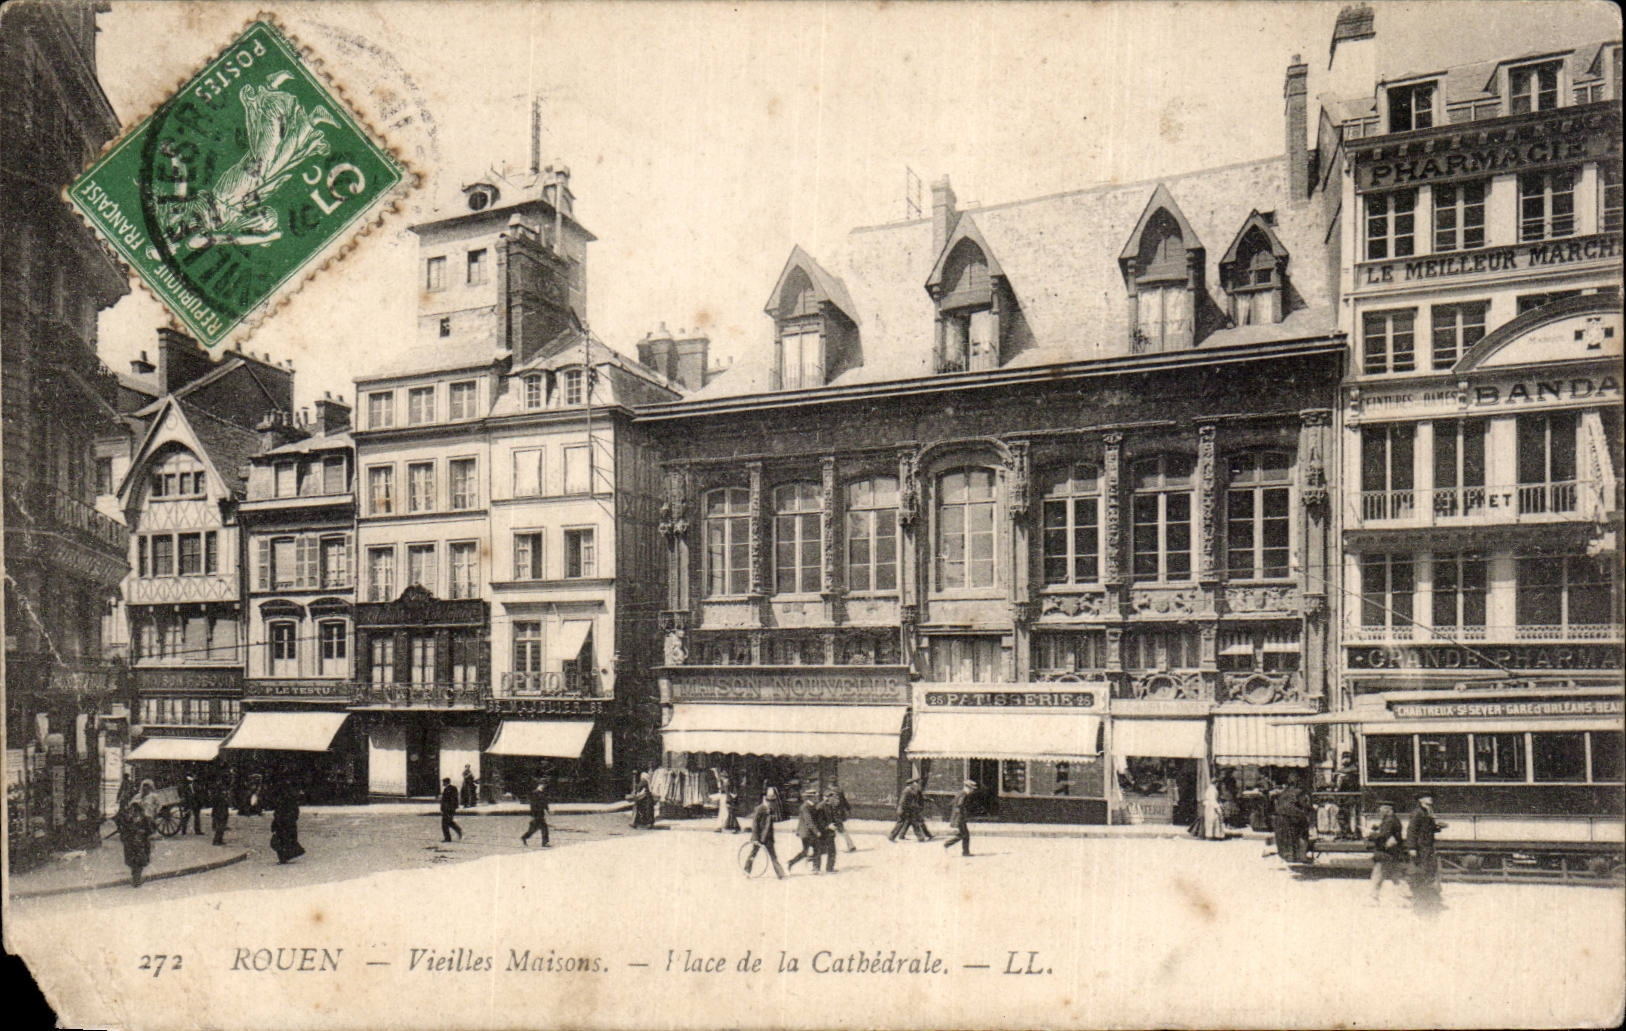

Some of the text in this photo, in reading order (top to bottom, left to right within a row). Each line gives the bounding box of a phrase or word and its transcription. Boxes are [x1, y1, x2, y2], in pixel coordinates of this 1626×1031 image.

[195, 38, 267, 103] POSTES
[1371, 143, 1587, 185] PHARMACIE
[80, 178, 147, 250] FRANÇAISE
[1367, 265, 1393, 285] LE
[1405, 249, 1517, 281] MEILLEUR
[1475, 376, 1620, 407] BANDA
[1369, 649, 1481, 669] GRANDE
[680, 676, 900, 697] MAISON NOUVELLE
[929, 695, 944, 705] 25
[947, 693, 1073, 706] PATISSERIE
[1397, 704, 1453, 717] CHARTREUX
[1468, 703, 1501, 716] SEVER
[1506, 703, 1531, 715] GARE
